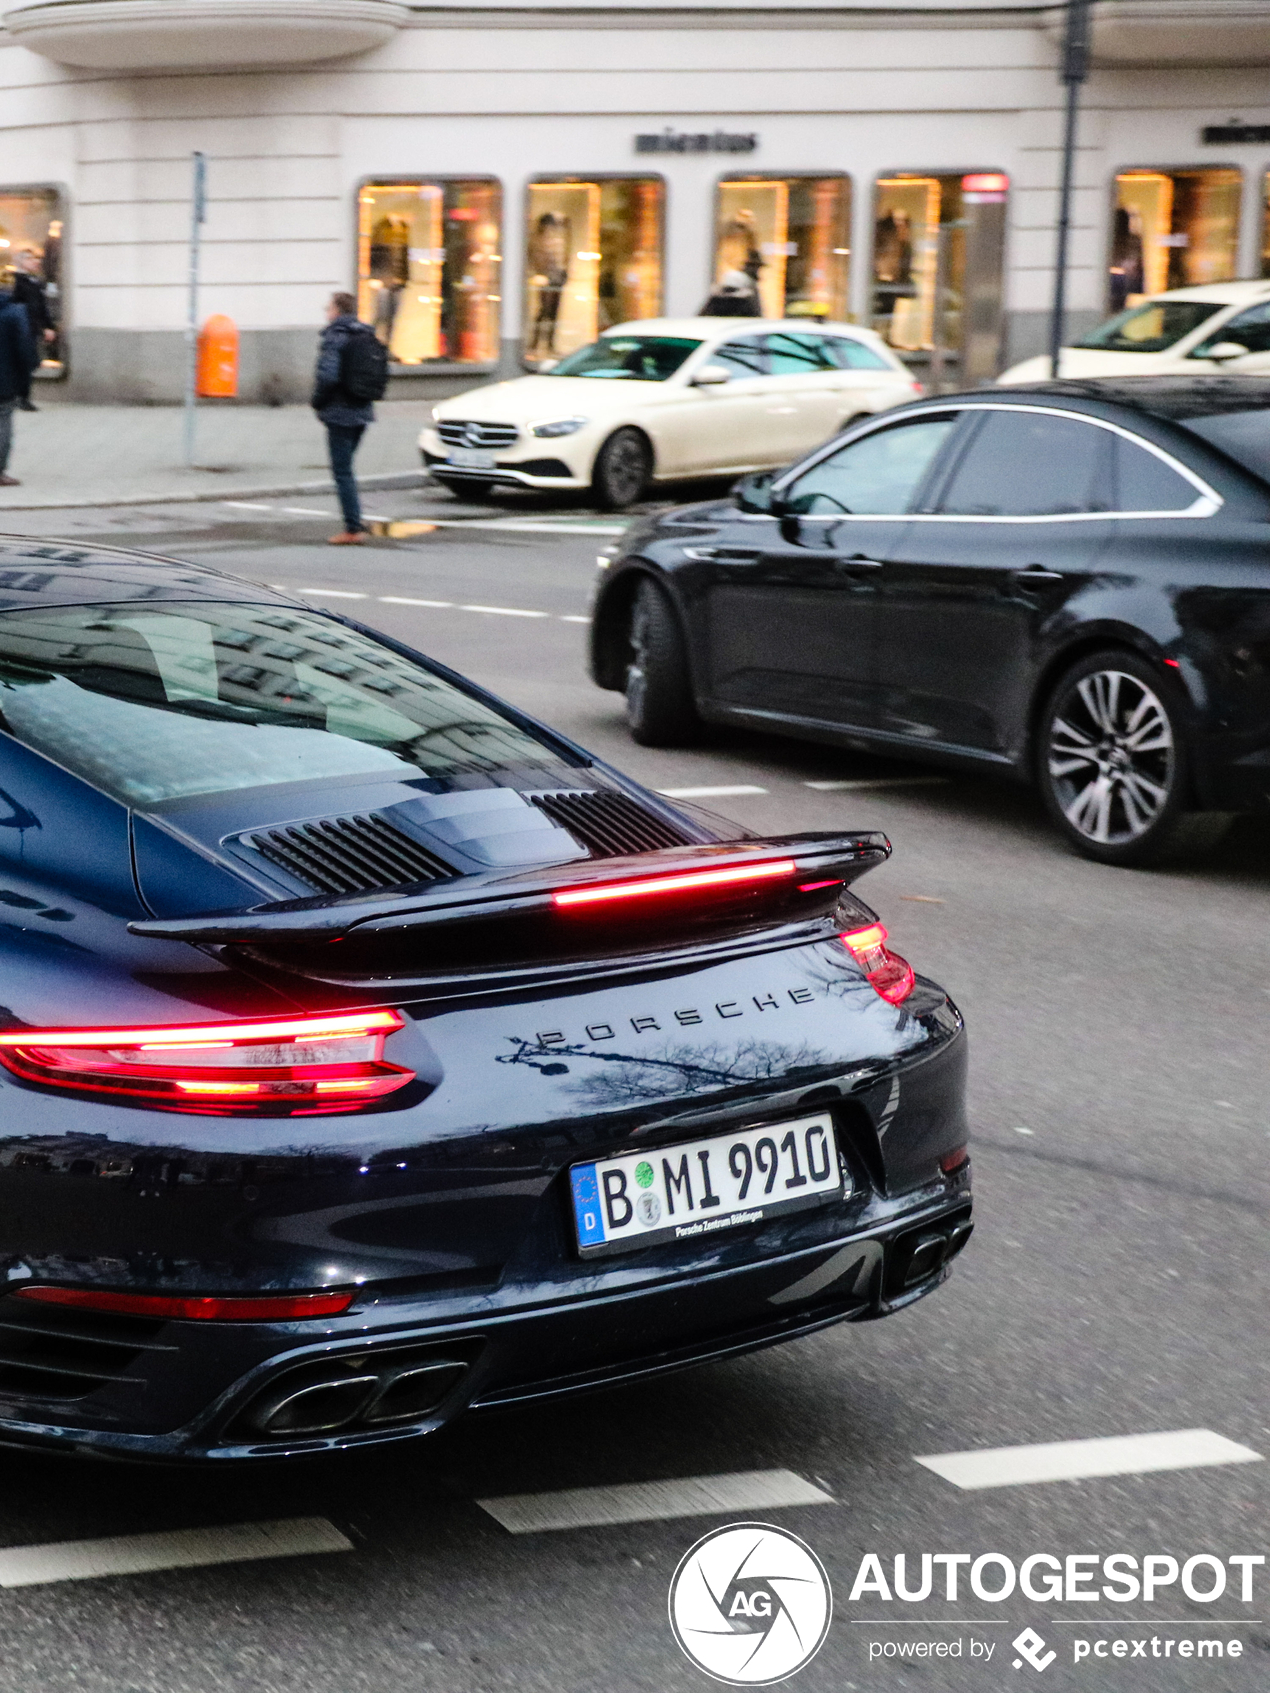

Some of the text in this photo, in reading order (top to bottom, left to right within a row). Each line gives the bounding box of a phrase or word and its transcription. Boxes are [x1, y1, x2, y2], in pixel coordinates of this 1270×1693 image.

[536, 987, 815, 1047] PORSCHE
[602, 1169, 633, 1229] B
[662, 1150, 720, 1214] MI
[728, 1125, 831, 1200] 9910
[584, 1212, 596, 1230] D
[675, 1223, 703, 1237] Porsche
[703, 1217, 731, 1231] Zentrum
